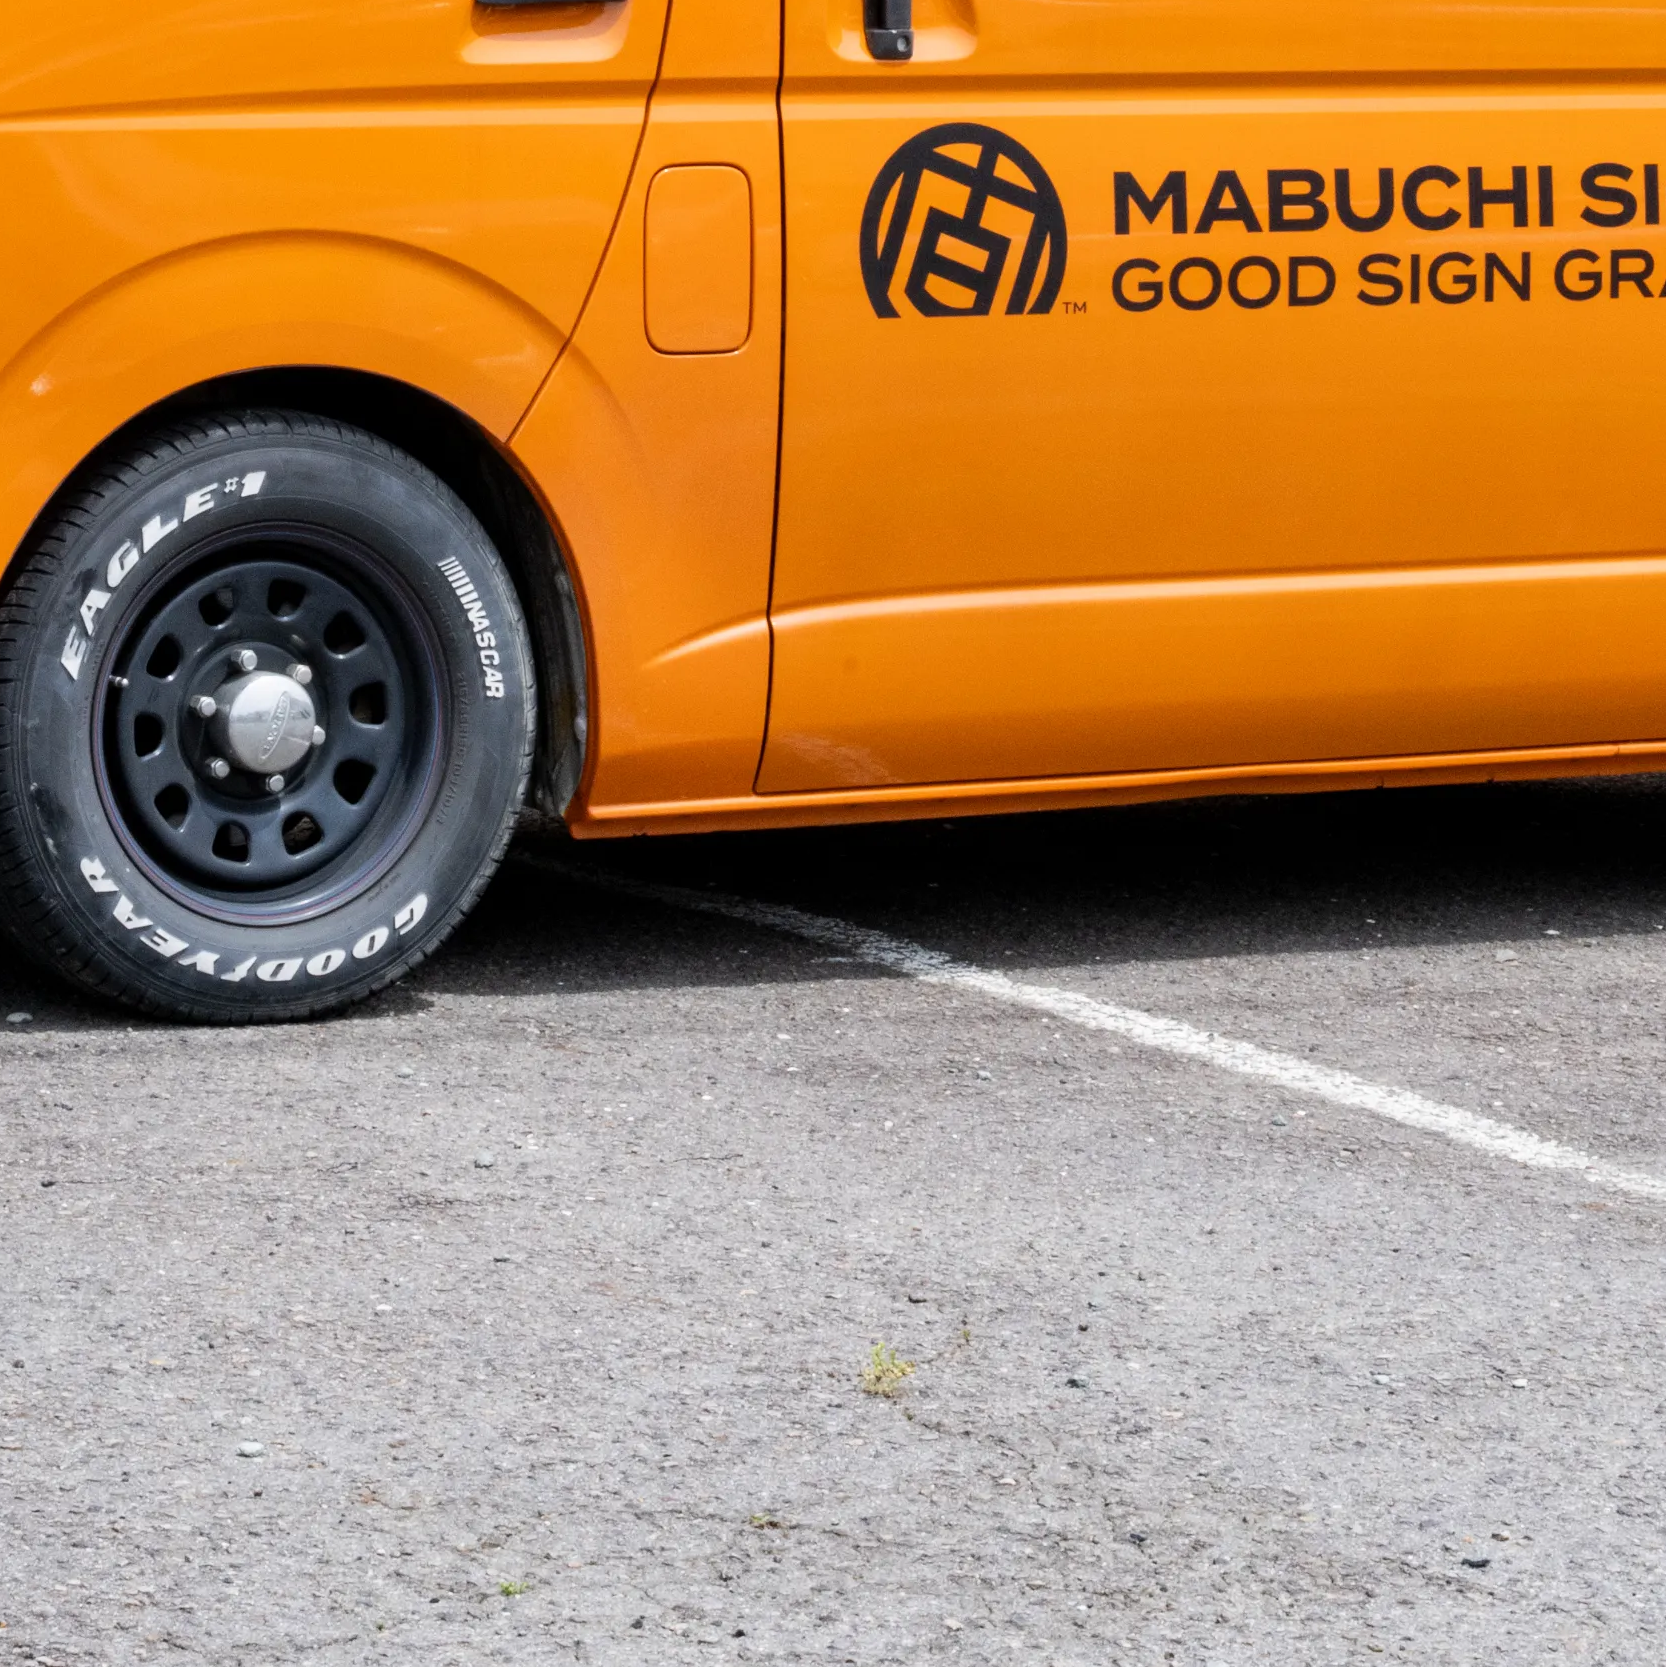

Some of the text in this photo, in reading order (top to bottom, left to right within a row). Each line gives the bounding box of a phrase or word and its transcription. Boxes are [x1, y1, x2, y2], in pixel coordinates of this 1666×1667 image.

[1113, 165, 1554, 235] MABUCHI
[1112, 255, 1336, 313] GOOD
[1357, 251, 1531, 306] SIGN
[464, 600, 505, 699] NASCAR
[80, 857, 428, 982] GOODYEAR
